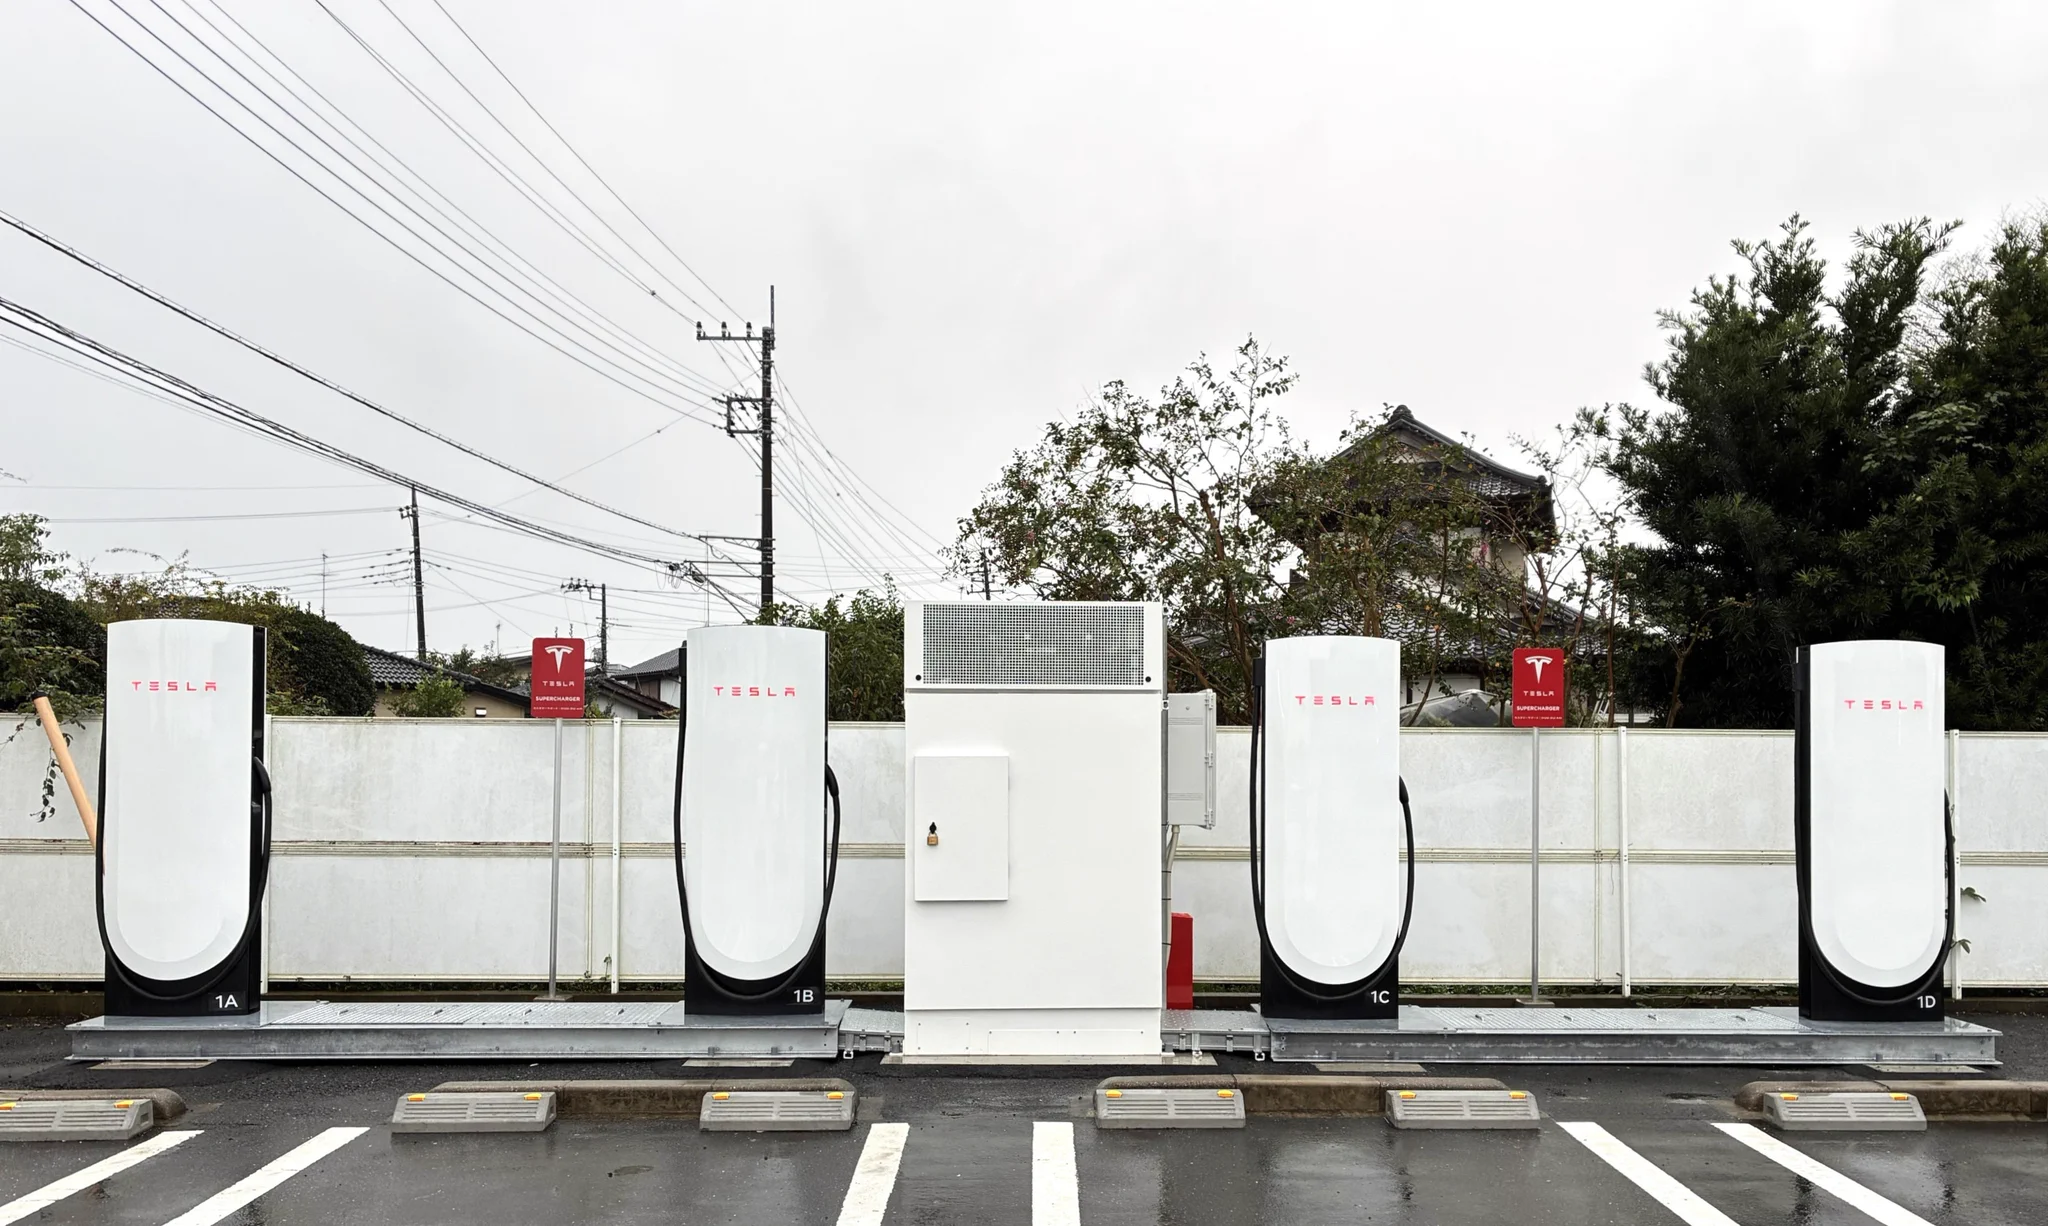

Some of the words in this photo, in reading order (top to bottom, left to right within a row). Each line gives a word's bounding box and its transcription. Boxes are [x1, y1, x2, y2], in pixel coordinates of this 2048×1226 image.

[131, 680, 218, 692] TESLA
[713, 685, 796, 697] TESLA
[1295, 695, 1376, 706] TESLA
[1843, 699, 1925, 711] TESLA
[215, 994, 239, 1009] 1A
[793, 989, 814, 1003] 1B
[1370, 990, 1390, 1004] 1C
[1917, 995, 1936, 1009] 1D
